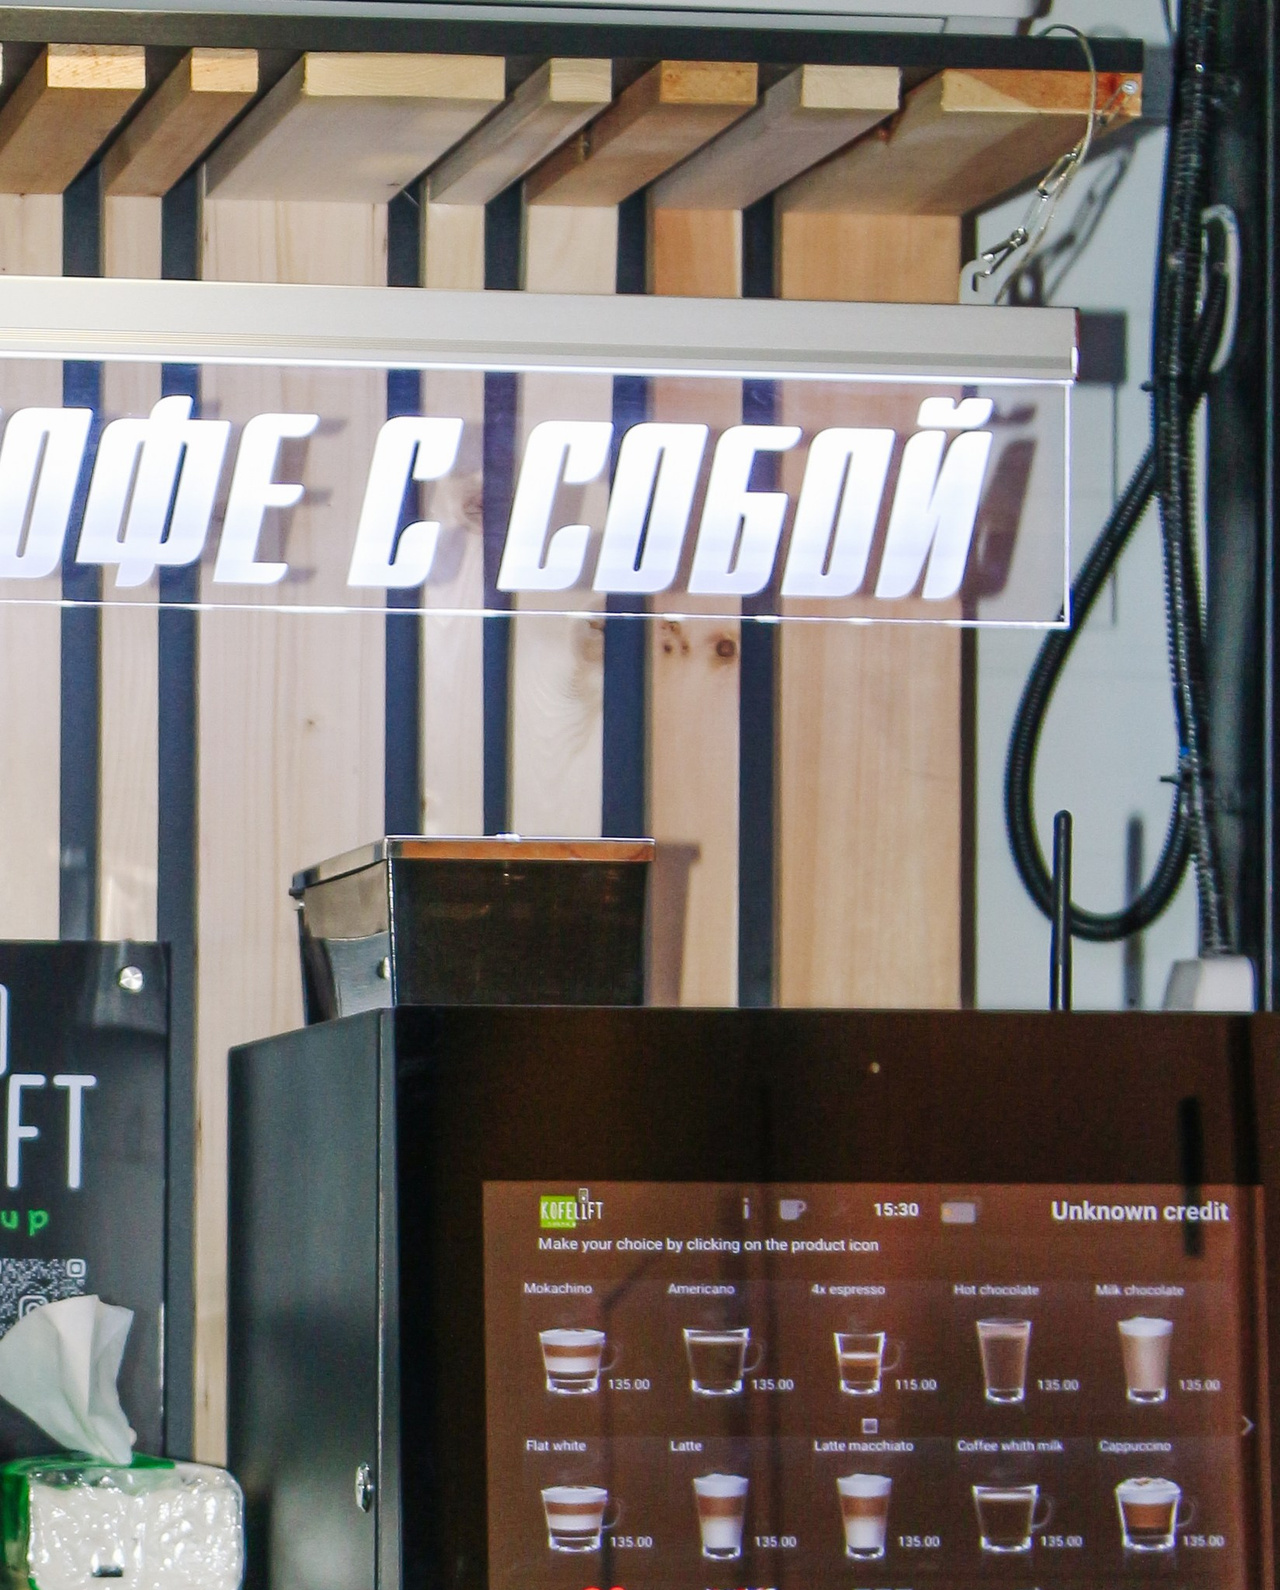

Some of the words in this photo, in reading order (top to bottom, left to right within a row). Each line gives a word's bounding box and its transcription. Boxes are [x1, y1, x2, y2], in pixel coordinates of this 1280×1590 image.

[347, 415, 463, 588] С
[497, 398, 993, 599] СОБОЙ
[540, 1201, 603, 1219] KOFELIFT
[874, 1203, 920, 1217] 15:30
[1051, 1201, 1158, 1221] Unknown
[1163, 1201, 1230, 1221] credit
[0, 1208, 50, 1236] up
[538, 1237, 577, 1251] Make
[581, 1240, 612, 1254] your
[616, 1237, 663, 1251] choice
[667, 1237, 683, 1254] by
[687, 1237, 741, 1254] clicking
[744, 1240, 762, 1251] on
[765, 1238, 788, 1251] the
[791, 1238, 846, 1254] product
[848, 1238, 879, 1251] icon
[524, 1282, 593, 1295] Mokachino
[668, 1282, 735, 1295] Americano
[829, 1284, 886, 1298] espresso
[953, 1284, 976, 1296] Hot
[980, 1284, 1040, 1296] chocolate
[1096, 1284, 1121, 1296] Milk
[1124, 1284, 1185, 1296] chocolate
[608, 1379, 650, 1390] 135.00
[753, 1379, 795, 1390] 135.00
[895, 1379, 937, 1391] 115.00
[1037, 1379, 1079, 1391] 135.00
[1179, 1379, 1221, 1391] 135.00
[526, 1440, 549, 1451] Flat
[553, 1440, 587, 1451] white
[670, 1440, 702, 1451] Latte
[814, 1440, 846, 1452] Latte
[849, 1440, 914, 1452] macchiato
[957, 1440, 998, 1452] Coffee
[1037, 1440, 1064, 1452] milk
[1099, 1440, 1172, 1455] Cappuccino
[610, 1536, 652, 1548] 135.00
[755, 1536, 797, 1548] 135.00
[898, 1536, 940, 1547] 135.00
[1041, 1536, 1083, 1547] 135.00
[1183, 1536, 1225, 1547] 135.00
